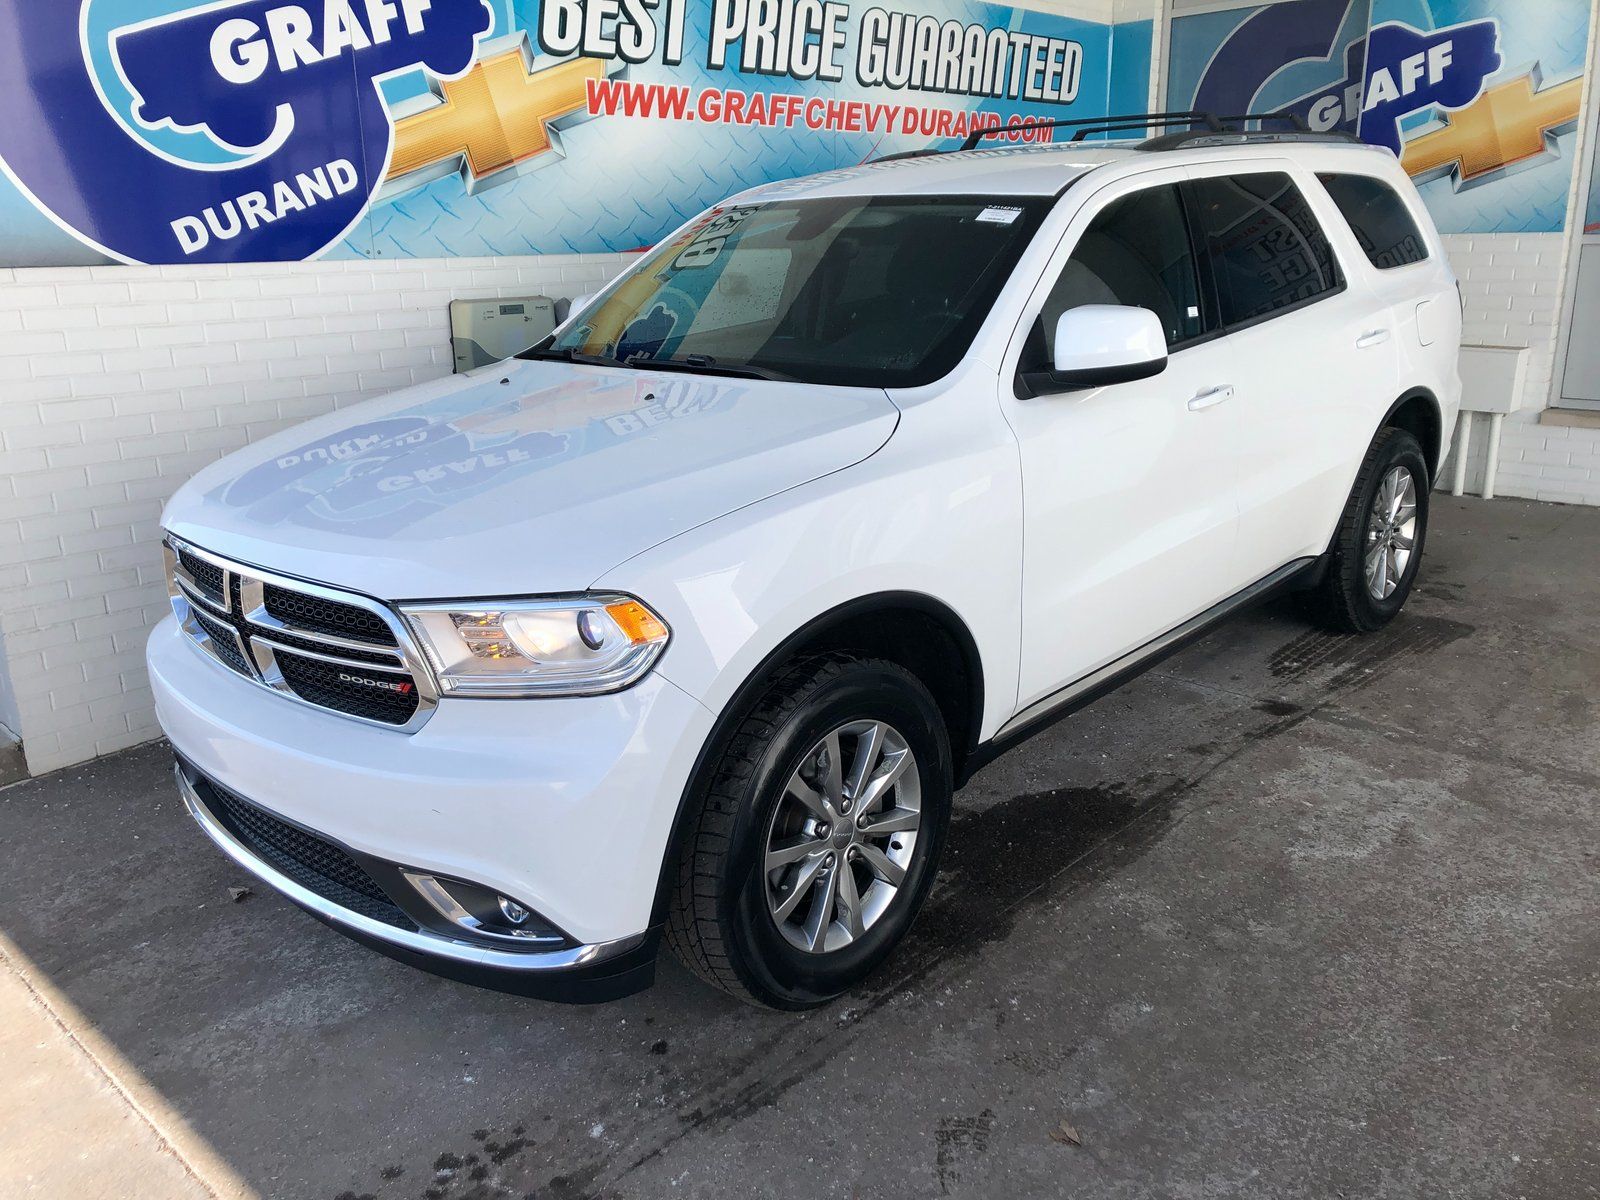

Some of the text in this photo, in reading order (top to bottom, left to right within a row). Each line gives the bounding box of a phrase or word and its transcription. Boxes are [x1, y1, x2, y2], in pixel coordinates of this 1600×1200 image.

[210, 0, 431, 84] GRAFF
[538, 0, 1083, 105] BEST PRICE GUARANTEED
[586, 78, 1055, 144] WWW.GRAFFCHEVYDURAND.COM
[170, 158, 358, 255] DURAND
[340, 673, 402, 691] DODGE
